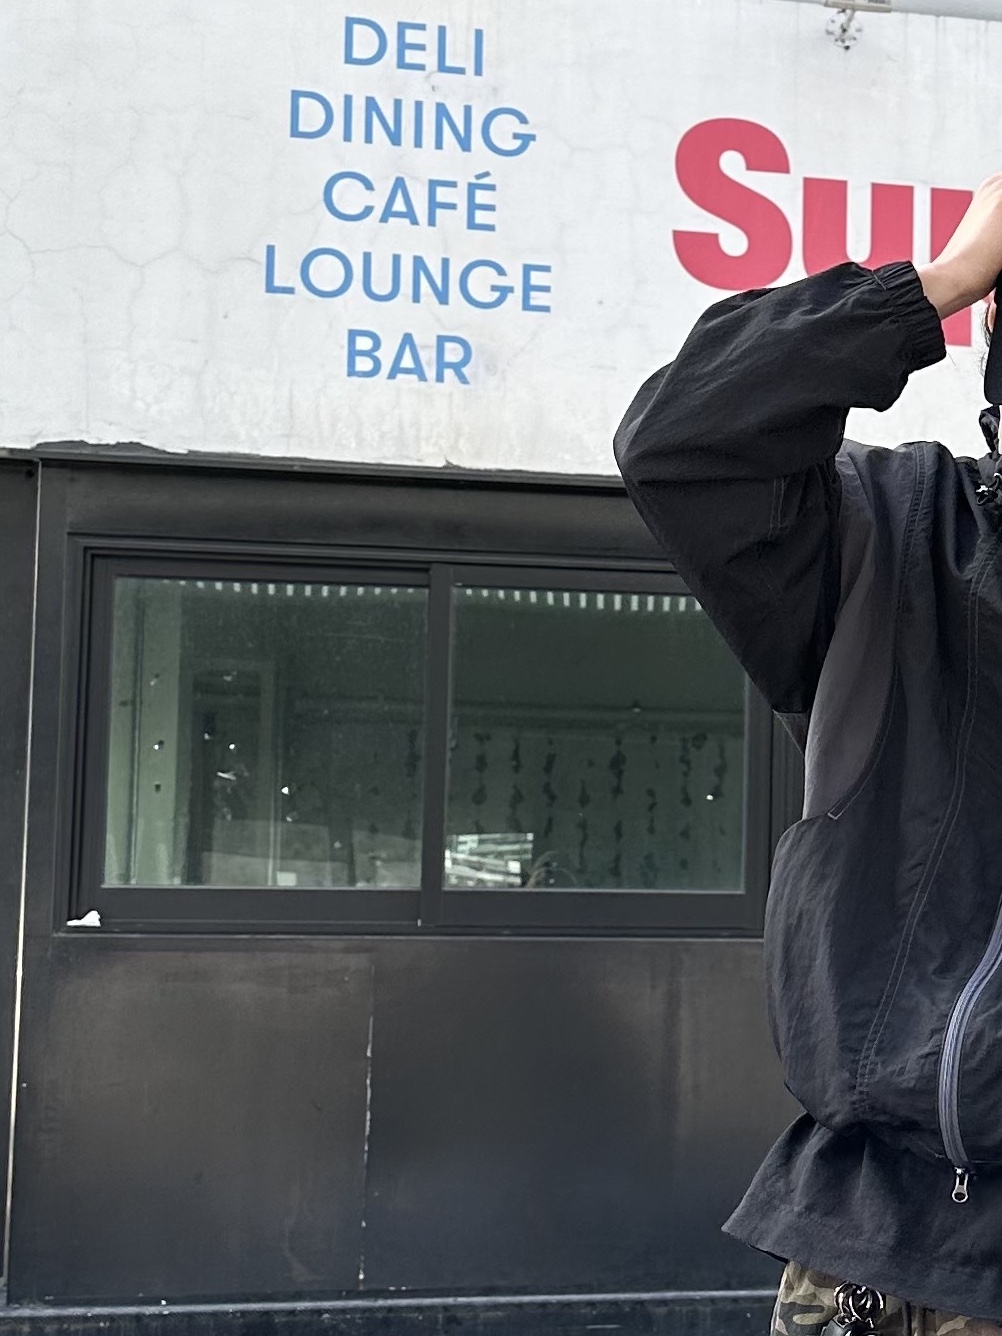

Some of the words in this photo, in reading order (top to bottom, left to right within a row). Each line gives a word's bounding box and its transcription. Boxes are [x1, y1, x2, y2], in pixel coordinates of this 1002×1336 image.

[343, 15, 484, 77] DELI
[289, 88, 537, 158] DINING
[322, 170, 497, 232] CAFÉ
[264, 244, 552, 313] LOUNGE
[345, 328, 474, 386] BAR
